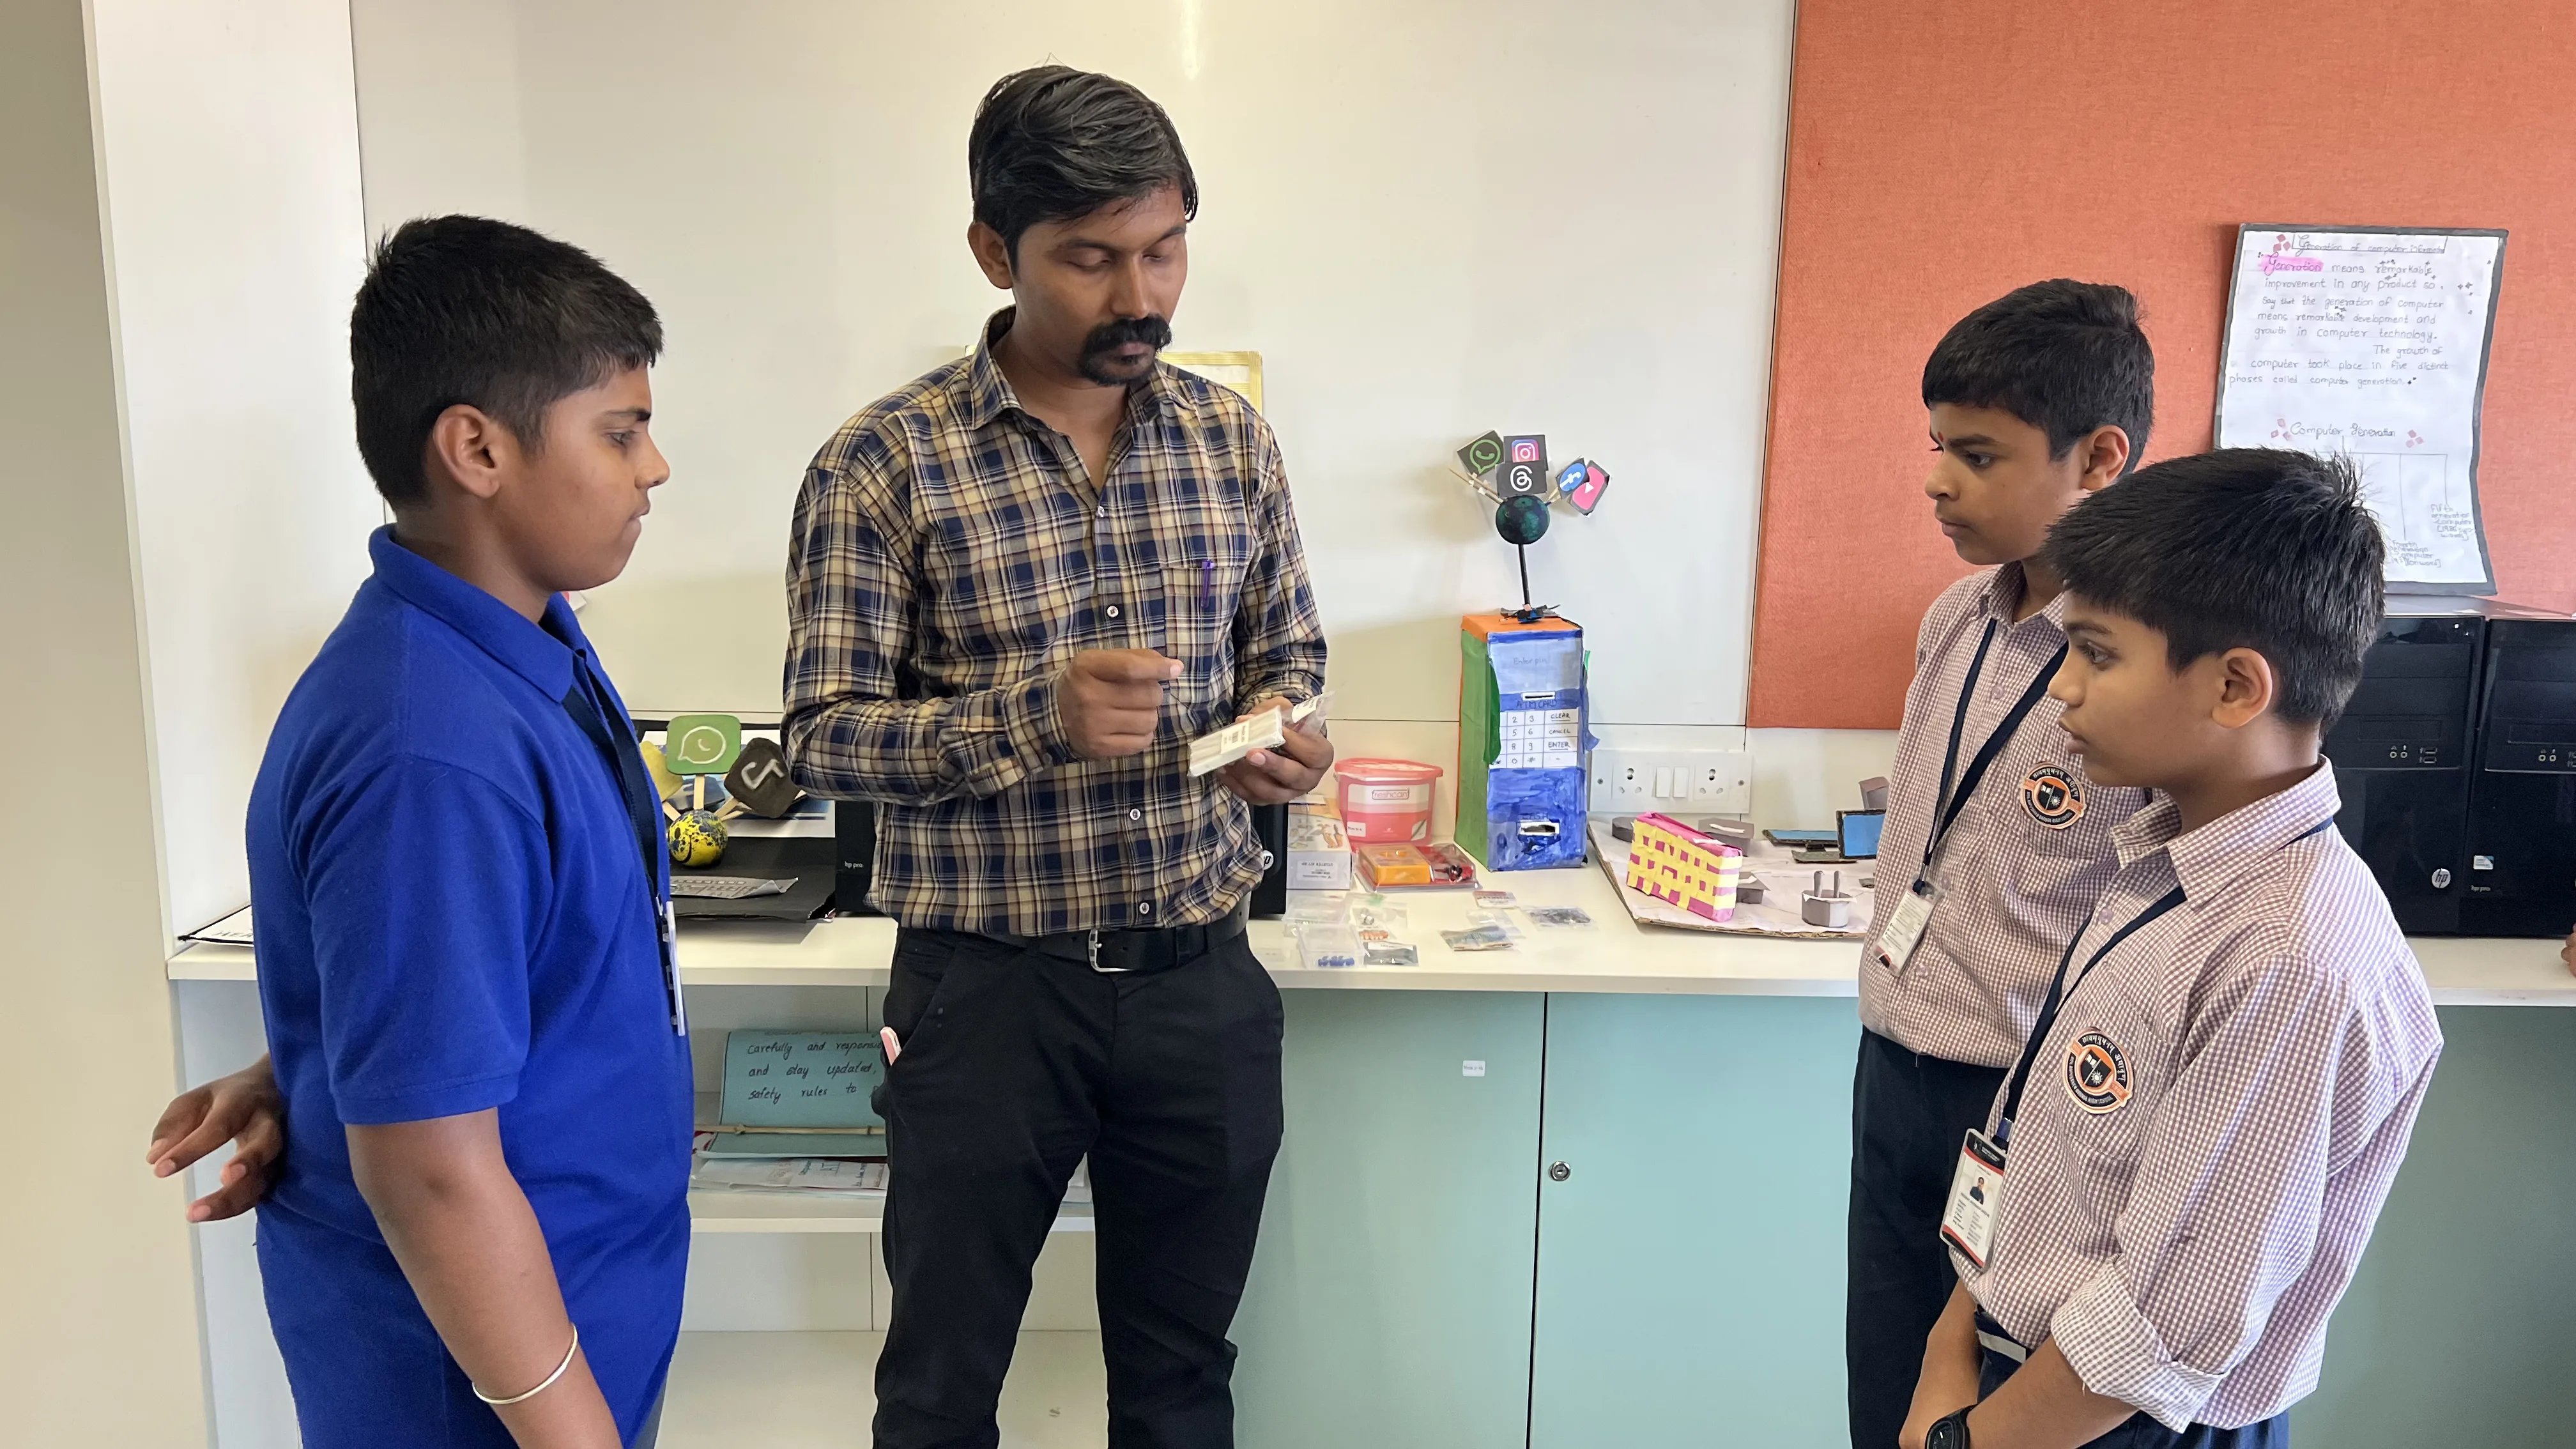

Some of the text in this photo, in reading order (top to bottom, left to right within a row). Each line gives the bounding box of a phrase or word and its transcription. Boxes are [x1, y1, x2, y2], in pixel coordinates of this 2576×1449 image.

[2264, 252, 2432, 276] Generation means remarkable
[2265, 278, 2326, 291] improvement
[2334, 279, 2344, 288] in
[2351, 280, 2370, 292] any
[2378, 278, 2417, 291] product
[2302, 295, 2315, 305] the
[2324, 296, 2373, 310] generation
[2379, 296, 2392, 307] of
[2398, 300, 2444, 312] computer
[2257, 312, 2288, 321] means
[2354, 314, 2409, 325] development
[2416, 314, 2436, 324] and
[2255, 326, 2286, 340] growth
[2297, 326, 2307, 337] in
[2317, 328, 2368, 341] computer
[2373, 344, 2443, 359] The growth of
[2251, 358, 2299, 371] computer
[2308, 358, 2331, 369] took
[2339, 360, 2363, 371] place
[2229, 373, 2263, 388] phases
[2273, 374, 2297, 383] called
[2290, 422, 2343, 440] Computer
[1529, 742, 1533, 751] 9
[2435, 869, 2449, 888] hp
[807, 1041, 826, 1051] and
[748, 1064, 769, 1077] and
[748, 1087, 781, 1105] safety
[801, 1085, 828, 1097] rules
[846, 1082, 857, 1094] to
